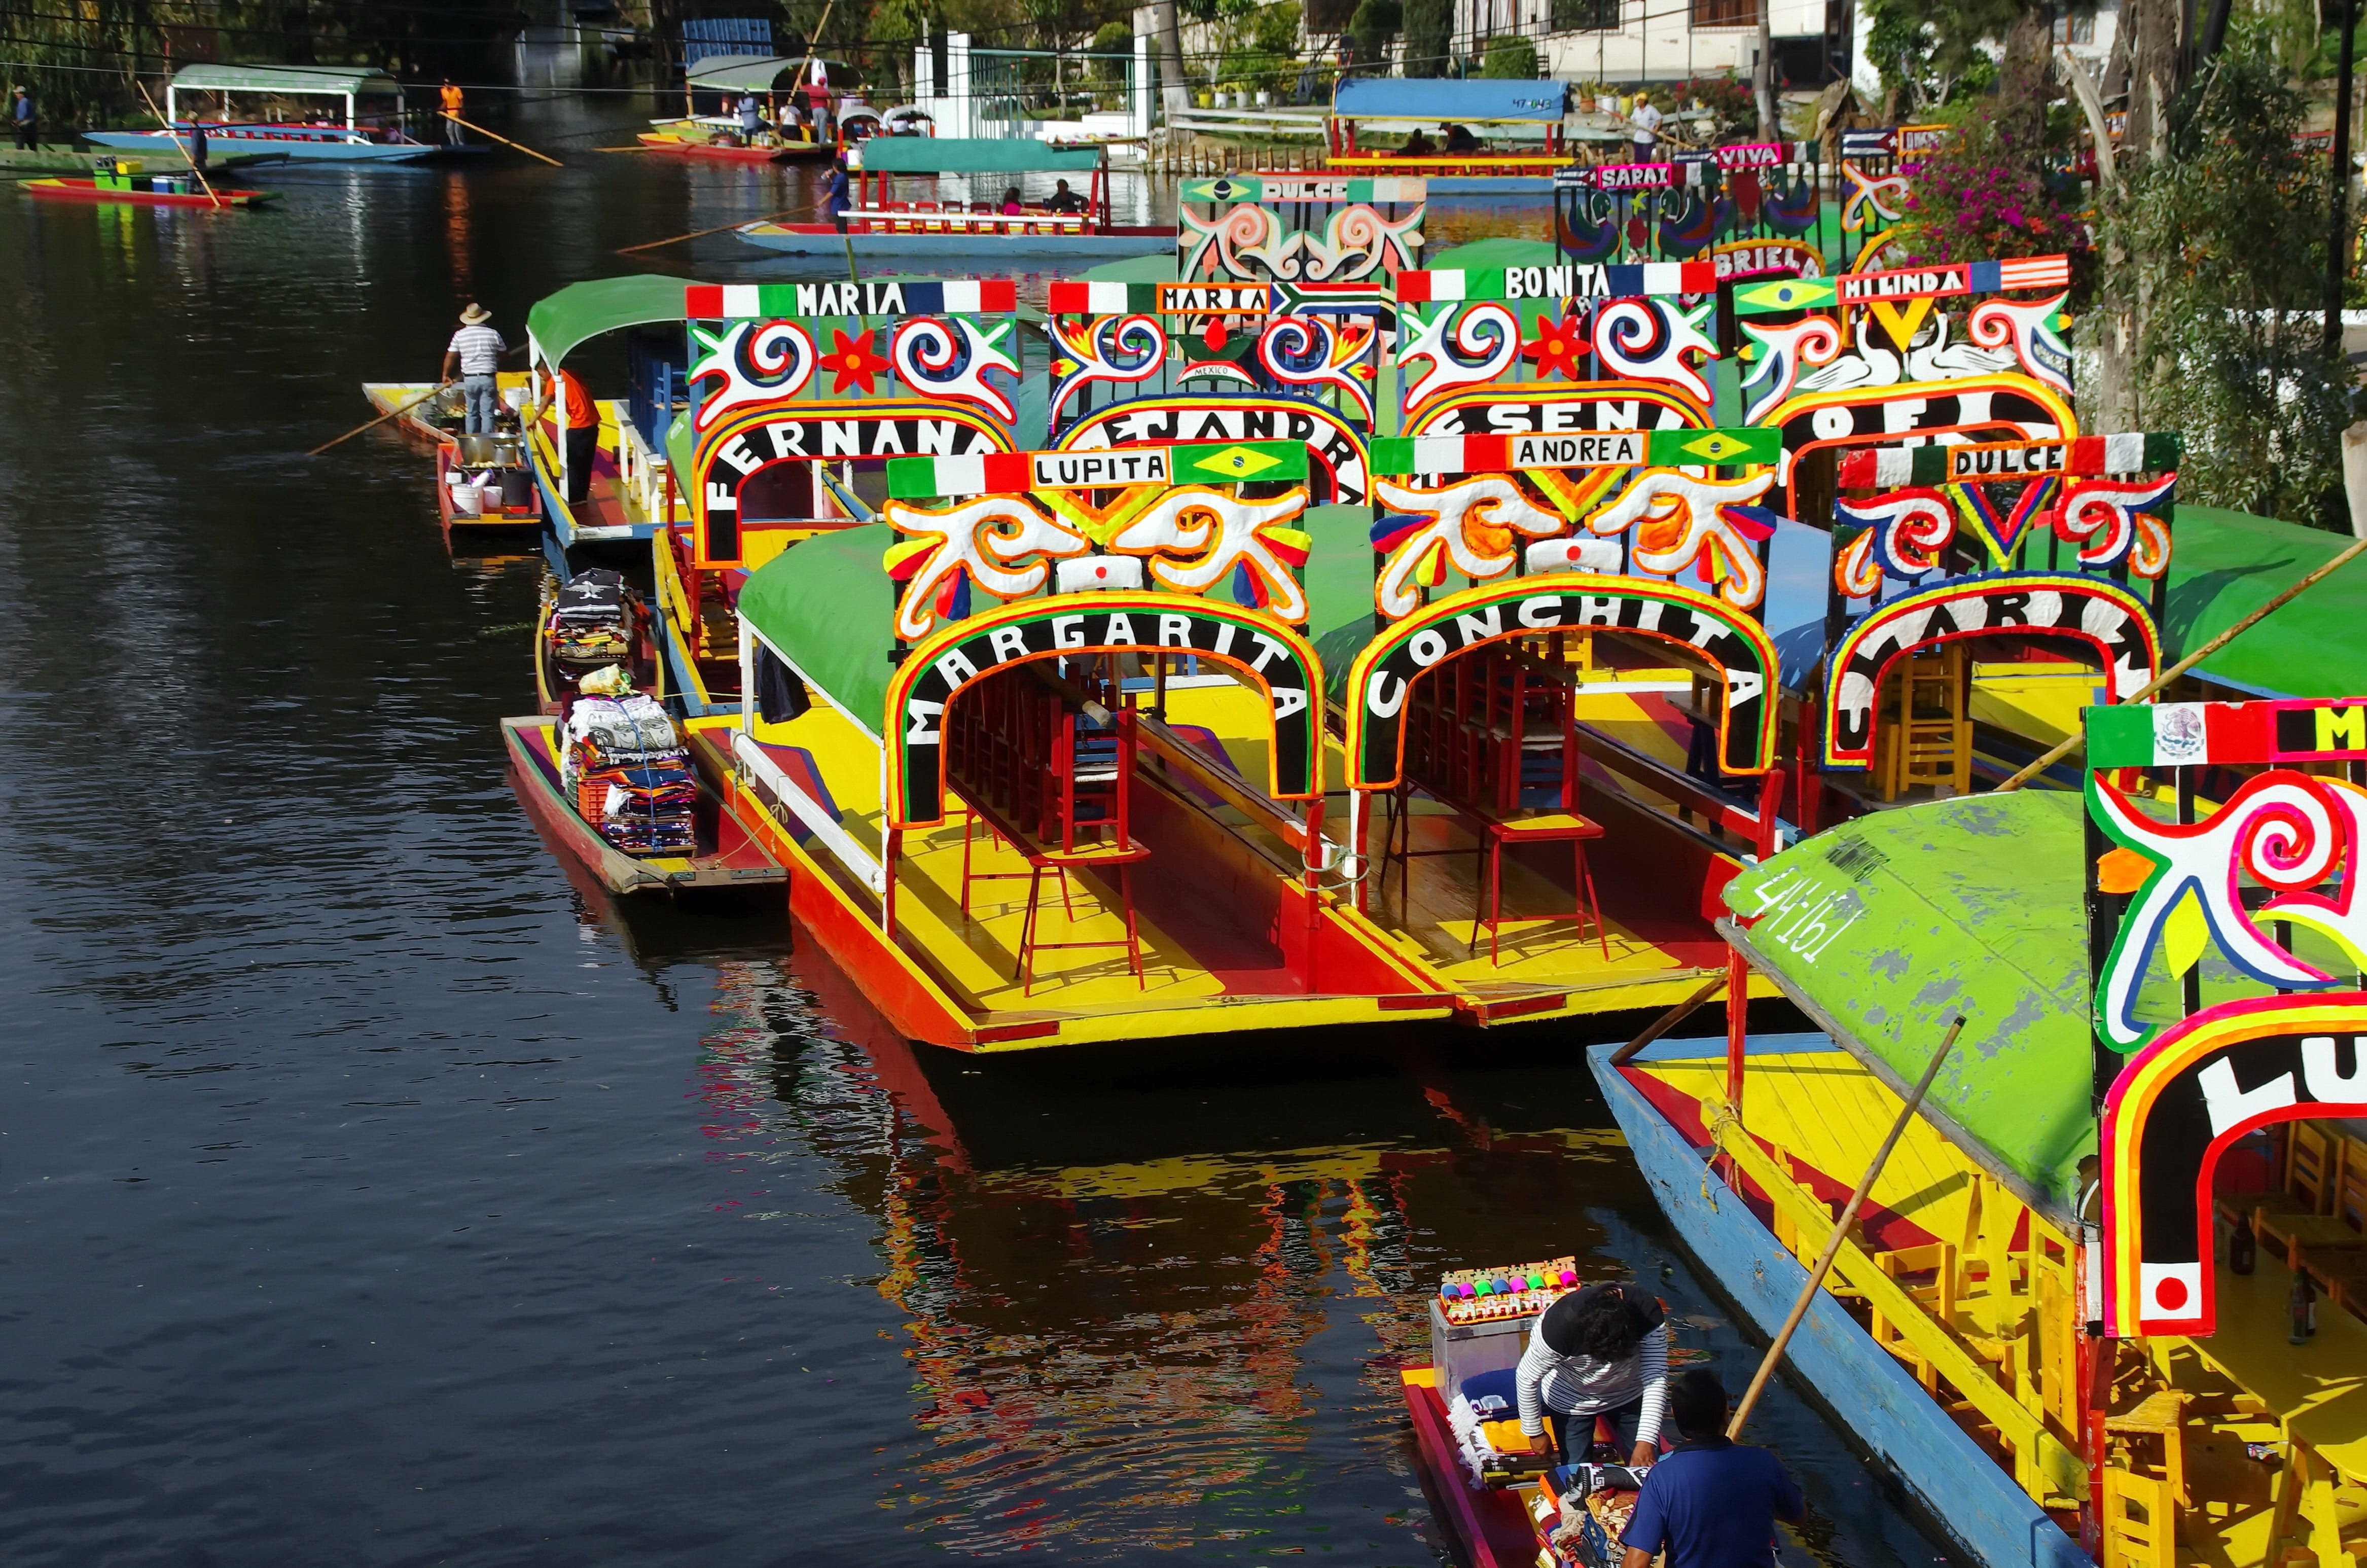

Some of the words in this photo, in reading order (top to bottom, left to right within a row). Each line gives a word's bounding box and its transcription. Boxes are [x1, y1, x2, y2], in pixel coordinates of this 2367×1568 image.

[1719, 147, 1778, 167] VIVA
[1262, 183, 1348, 198] DULCE
[1601, 168, 1668, 188] SARAI
[1713, 246, 1820, 279] BRIELA
[1505, 264, 1611, 299] BONITA
[796, 282, 906, 316] MARIA
[1163, 289, 1265, 310] MARIA
[1195, 366, 1229, 376] MEXICO
[1102, 411, 1365, 506] EJANDRA
[1519, 437, 1634, 462] ANDREA
[1956, 444, 2063, 475] DULCE
[1037, 455, 1165, 485] LUPITA
[1367, 595, 1764, 719] CONCHITA
[1837, 591, 2150, 751] CLARIT
[907, 613, 1307, 745] MARGARITA
